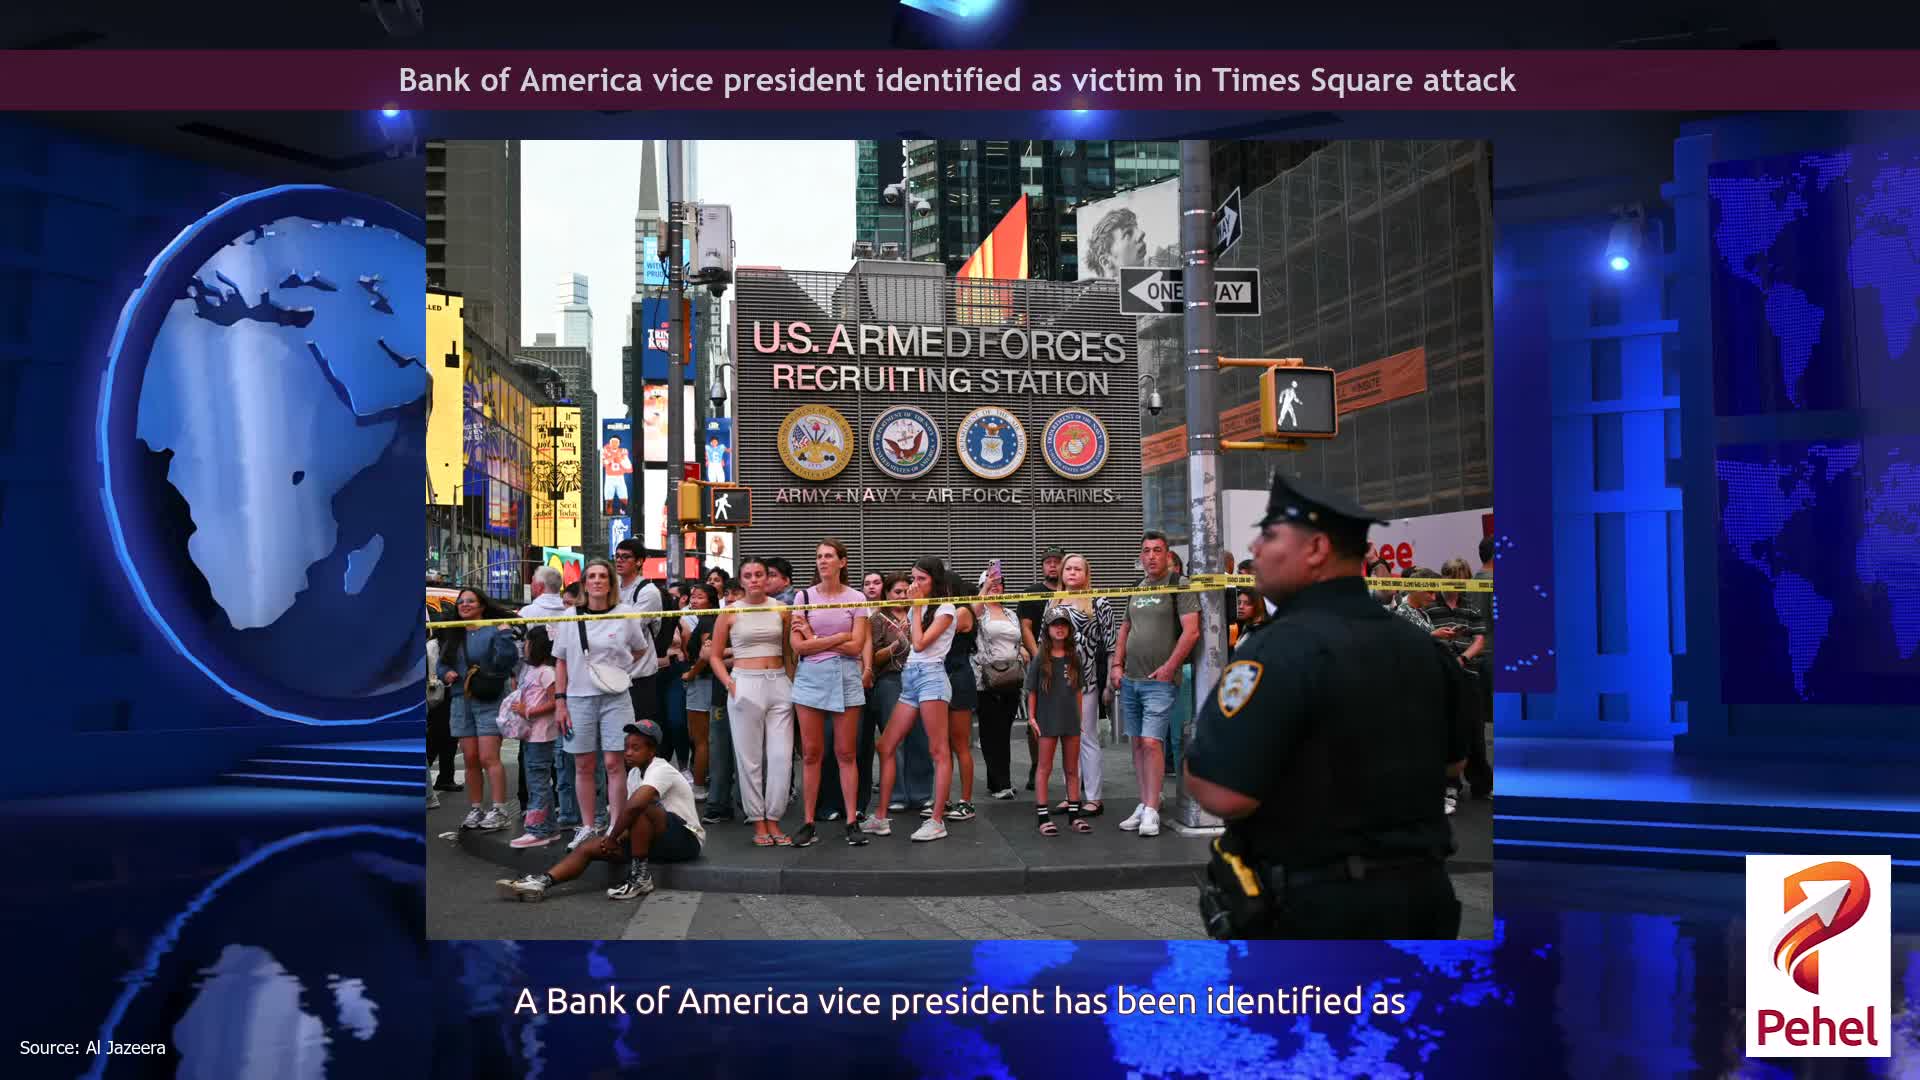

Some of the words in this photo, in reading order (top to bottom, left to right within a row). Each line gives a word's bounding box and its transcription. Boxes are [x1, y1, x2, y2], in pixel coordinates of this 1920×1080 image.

[1147, 282, 1184, 300] ONE
[1216, 283, 1244, 301] AY
[753, 320, 819, 354] U.S.
[826, 323, 972, 358] ARMED
[979, 327, 1127, 364] FORCES
[773, 363, 972, 393] RECRUITING
[980, 368, 1109, 396] STATION
[776, 488, 830, 503] ARMY
[847, 488, 902, 503] NAVY
[926, 488, 954, 504] AIR
[962, 488, 1022, 504] FORCE
[1040, 489, 1114, 504] MARINES
[1379, 541, 1413, 569] ee
